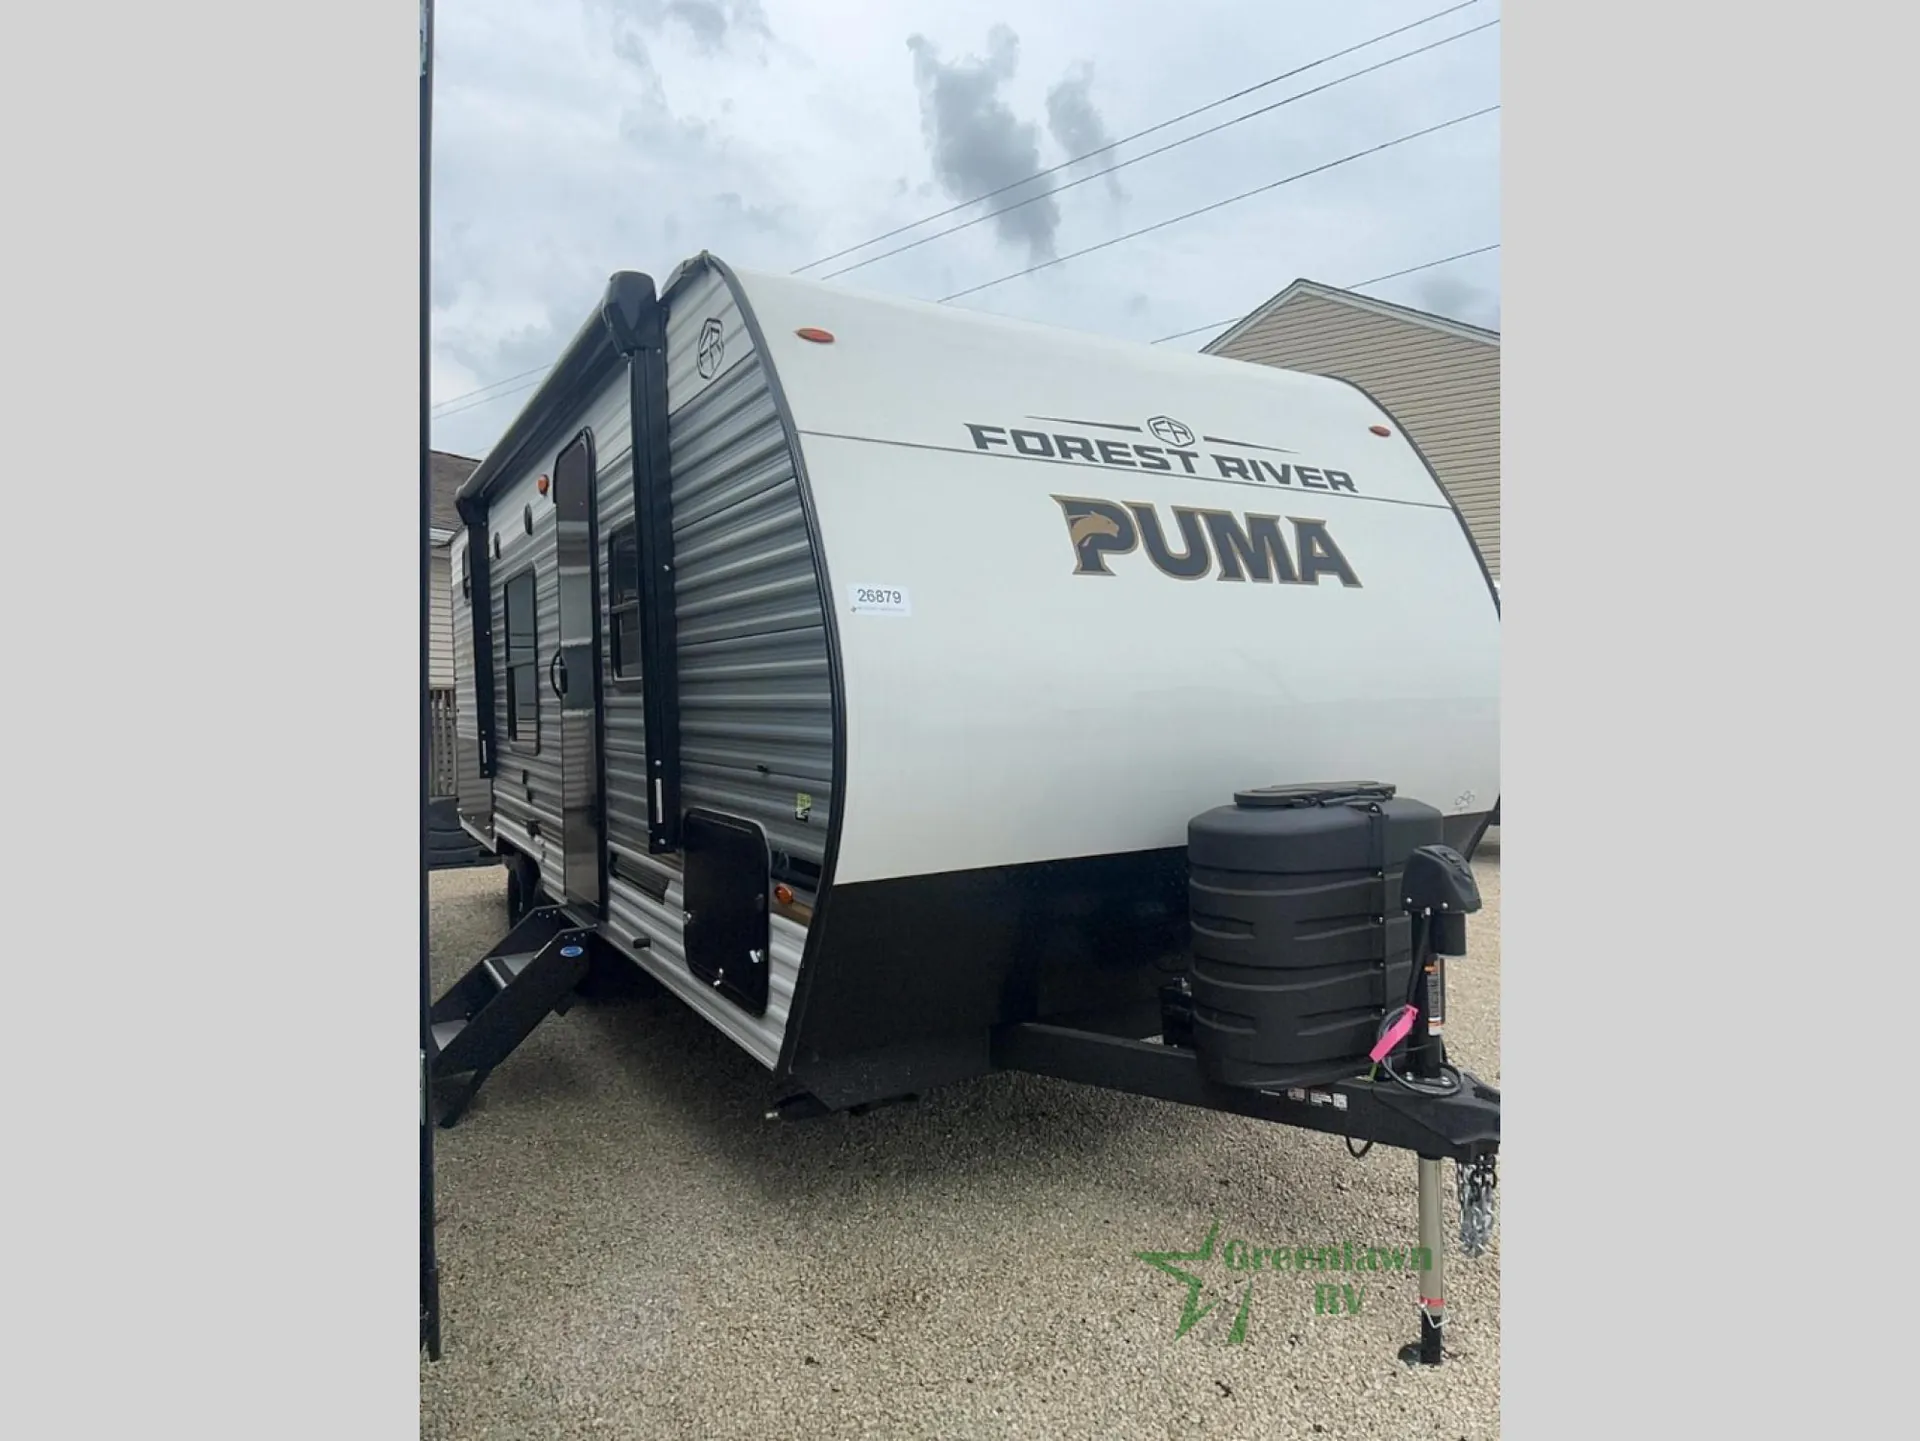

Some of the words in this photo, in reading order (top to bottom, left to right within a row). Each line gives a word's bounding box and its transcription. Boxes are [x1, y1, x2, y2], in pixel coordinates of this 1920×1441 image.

[964, 422, 1199, 474] FOREST
[1210, 453, 1359, 493] RIVER
[1049, 494, 1363, 588] PUMA
[857, 588, 902, 604] 26879
